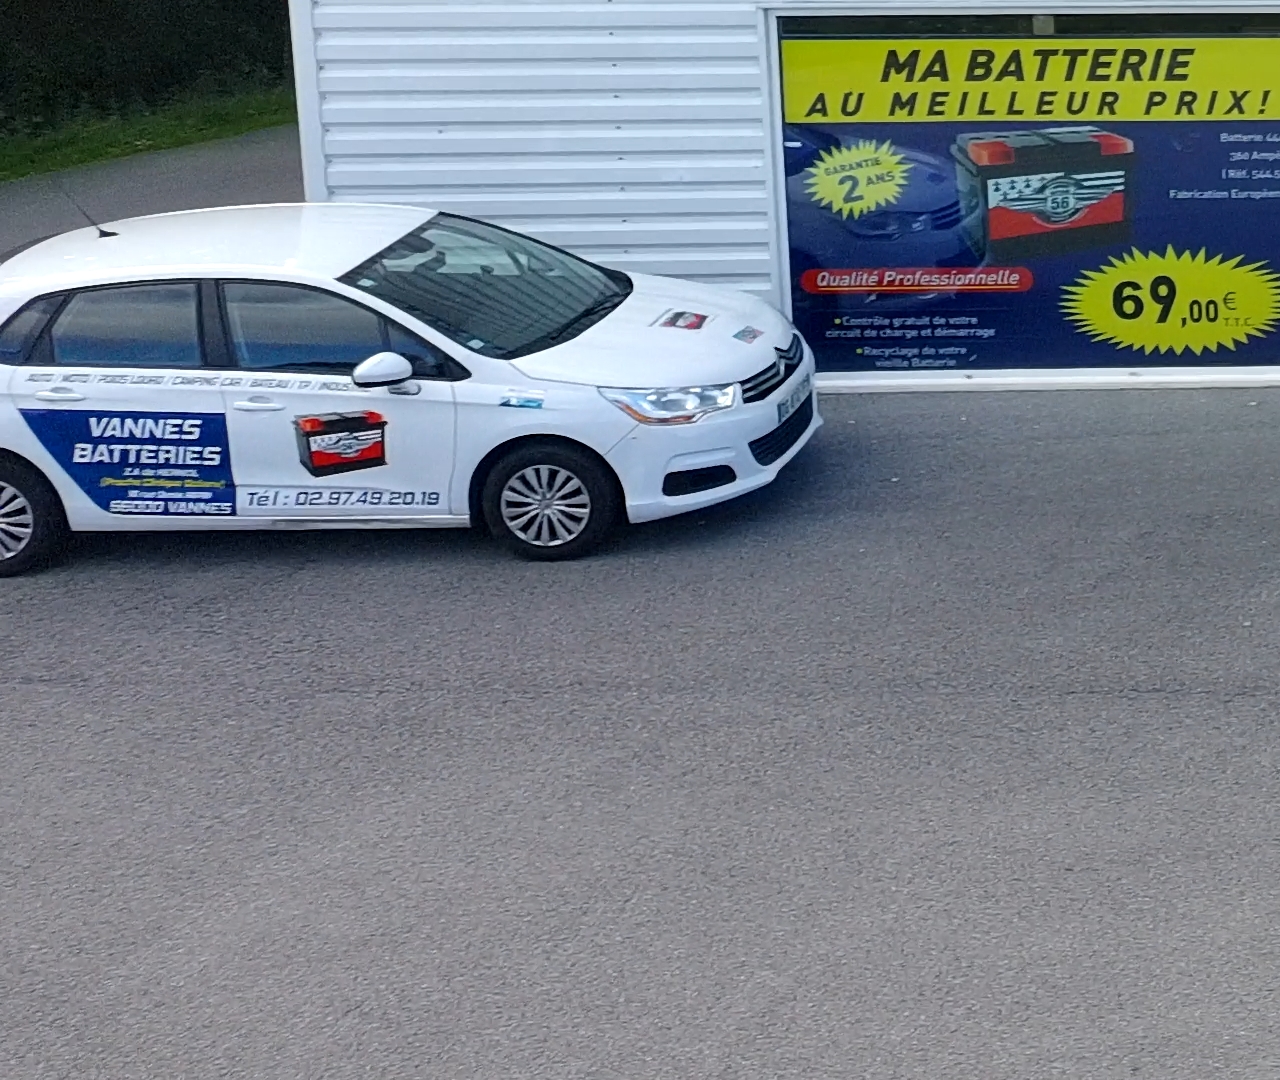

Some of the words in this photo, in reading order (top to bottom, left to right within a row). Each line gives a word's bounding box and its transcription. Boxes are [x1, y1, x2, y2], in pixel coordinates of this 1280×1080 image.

[881, 49, 950, 83] MA
[965, 48, 1194, 82] BATTERIE
[805, 92, 865, 117] AU
[888, 91, 1118, 117] MEILLEUR
[1144, 90, 1271, 116] PRIX!
[824, 157, 881, 176] GARANTIE
[838, 175, 864, 204] 2
[865, 171, 895, 187] ANS
[1051, 197, 1069, 210] 56
[816, 271, 879, 287] Qualité
[882, 269, 1020, 287] Professionnelle
[89, 418, 203, 440] VANNES
[72, 443, 222, 466] BATTERIES
[167, 502, 232, 514] VANNES
[295, 492, 440, 506] 02.97.49.20.19
